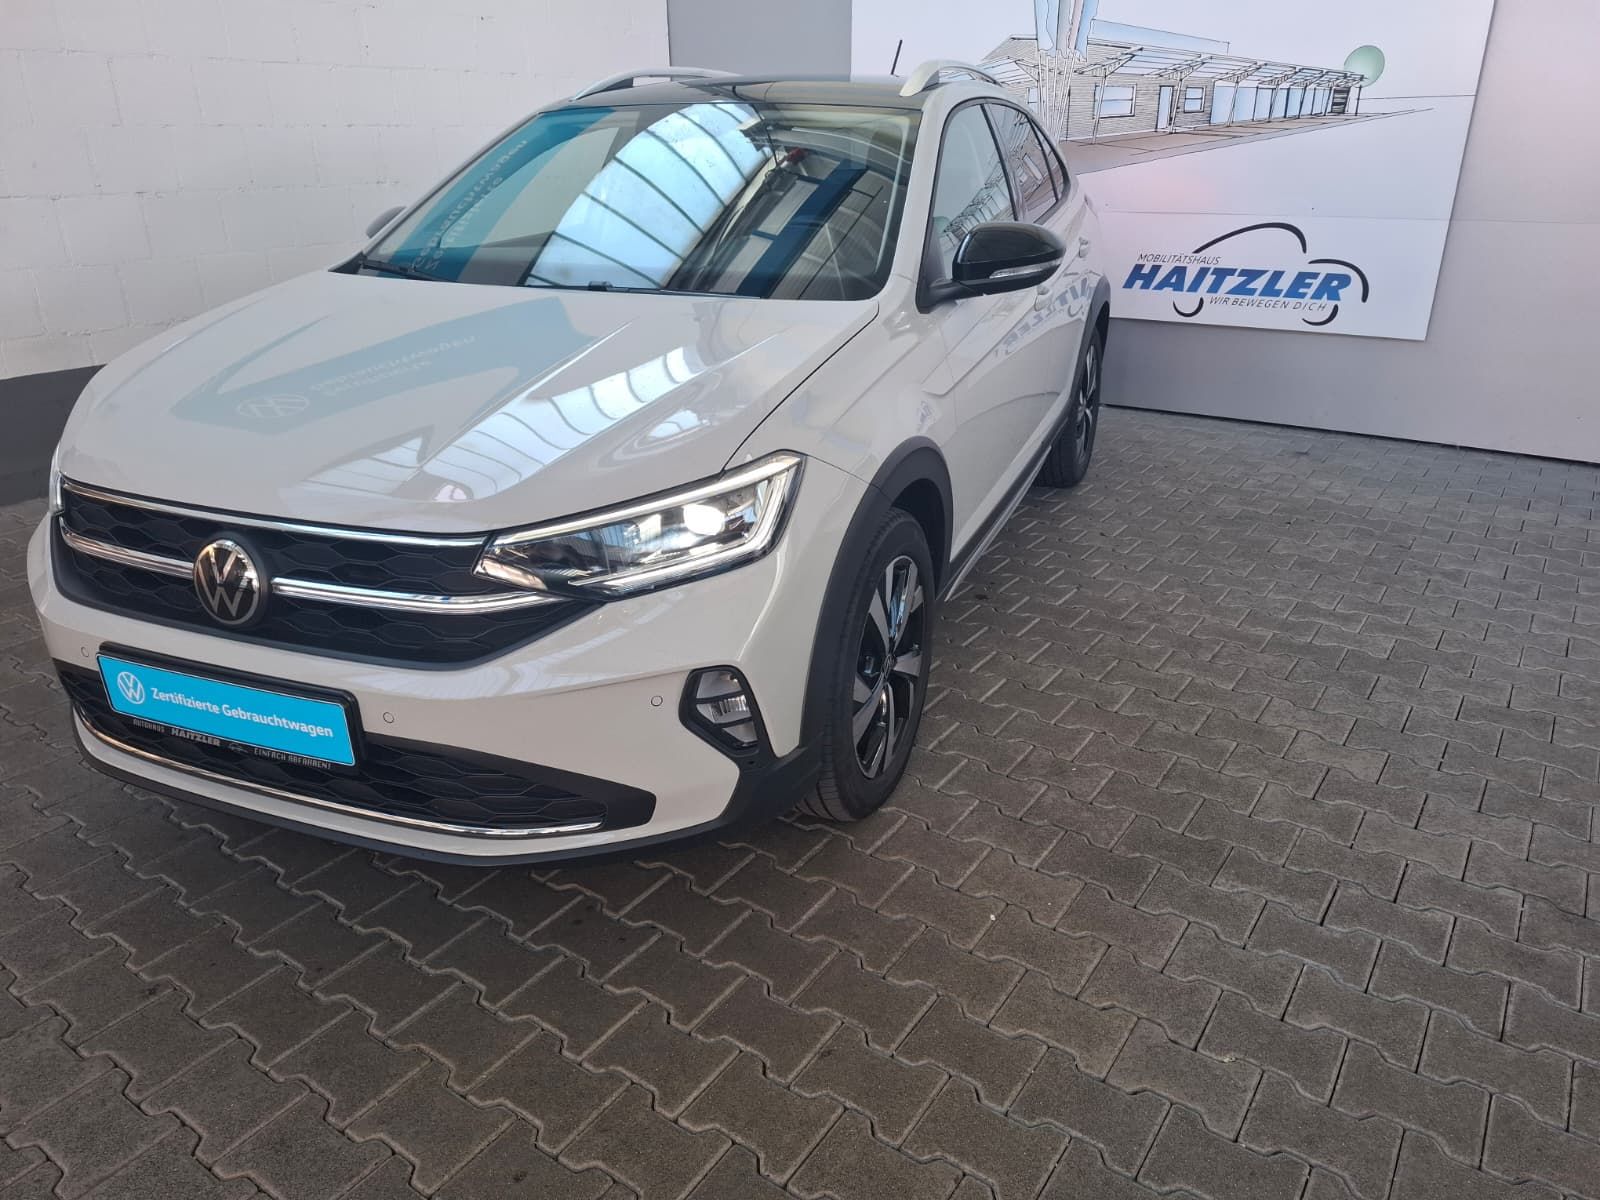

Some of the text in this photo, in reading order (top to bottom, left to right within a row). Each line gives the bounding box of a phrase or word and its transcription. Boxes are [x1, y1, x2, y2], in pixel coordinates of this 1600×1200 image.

[1137, 252, 1222, 265] MOBILITÄTSHAUS
[1122, 263, 1352, 301] HAITZLER
[1209, 296, 1328, 312] WIR BEWEGEN DICH
[151, 688, 334, 738] Zertifizierte Gebrauchtwagen
[172, 728, 220, 747] HAITZLER
[254, 748, 286, 761] EINFACH
